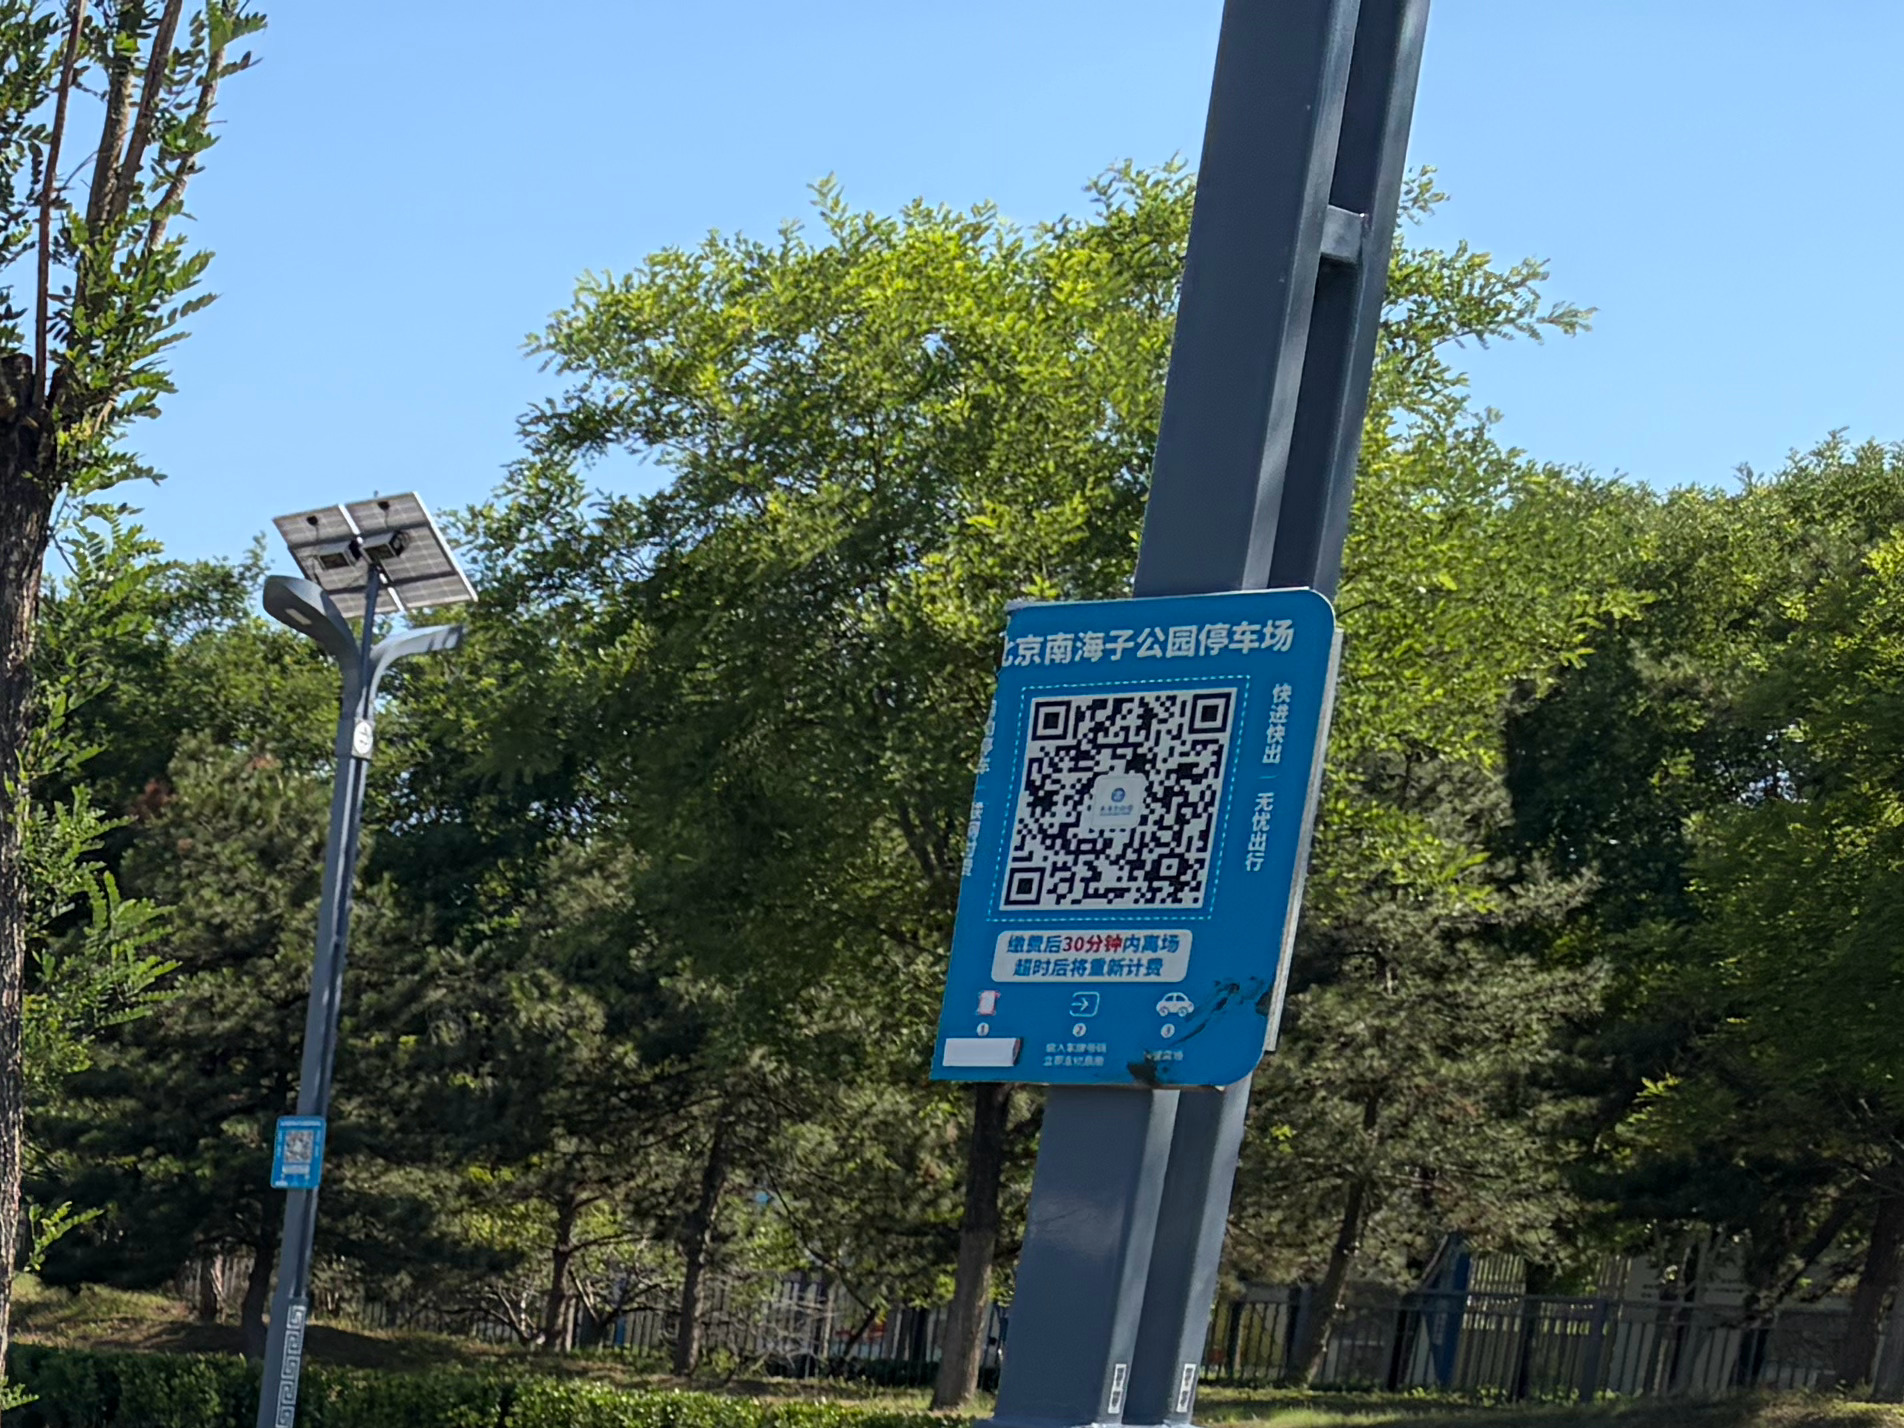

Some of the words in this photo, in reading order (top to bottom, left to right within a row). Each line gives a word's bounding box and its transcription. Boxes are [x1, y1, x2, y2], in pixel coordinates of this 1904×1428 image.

[1261, 682, 1293, 765] 快进快出
[1244, 791, 1275, 872] 无忧出行
